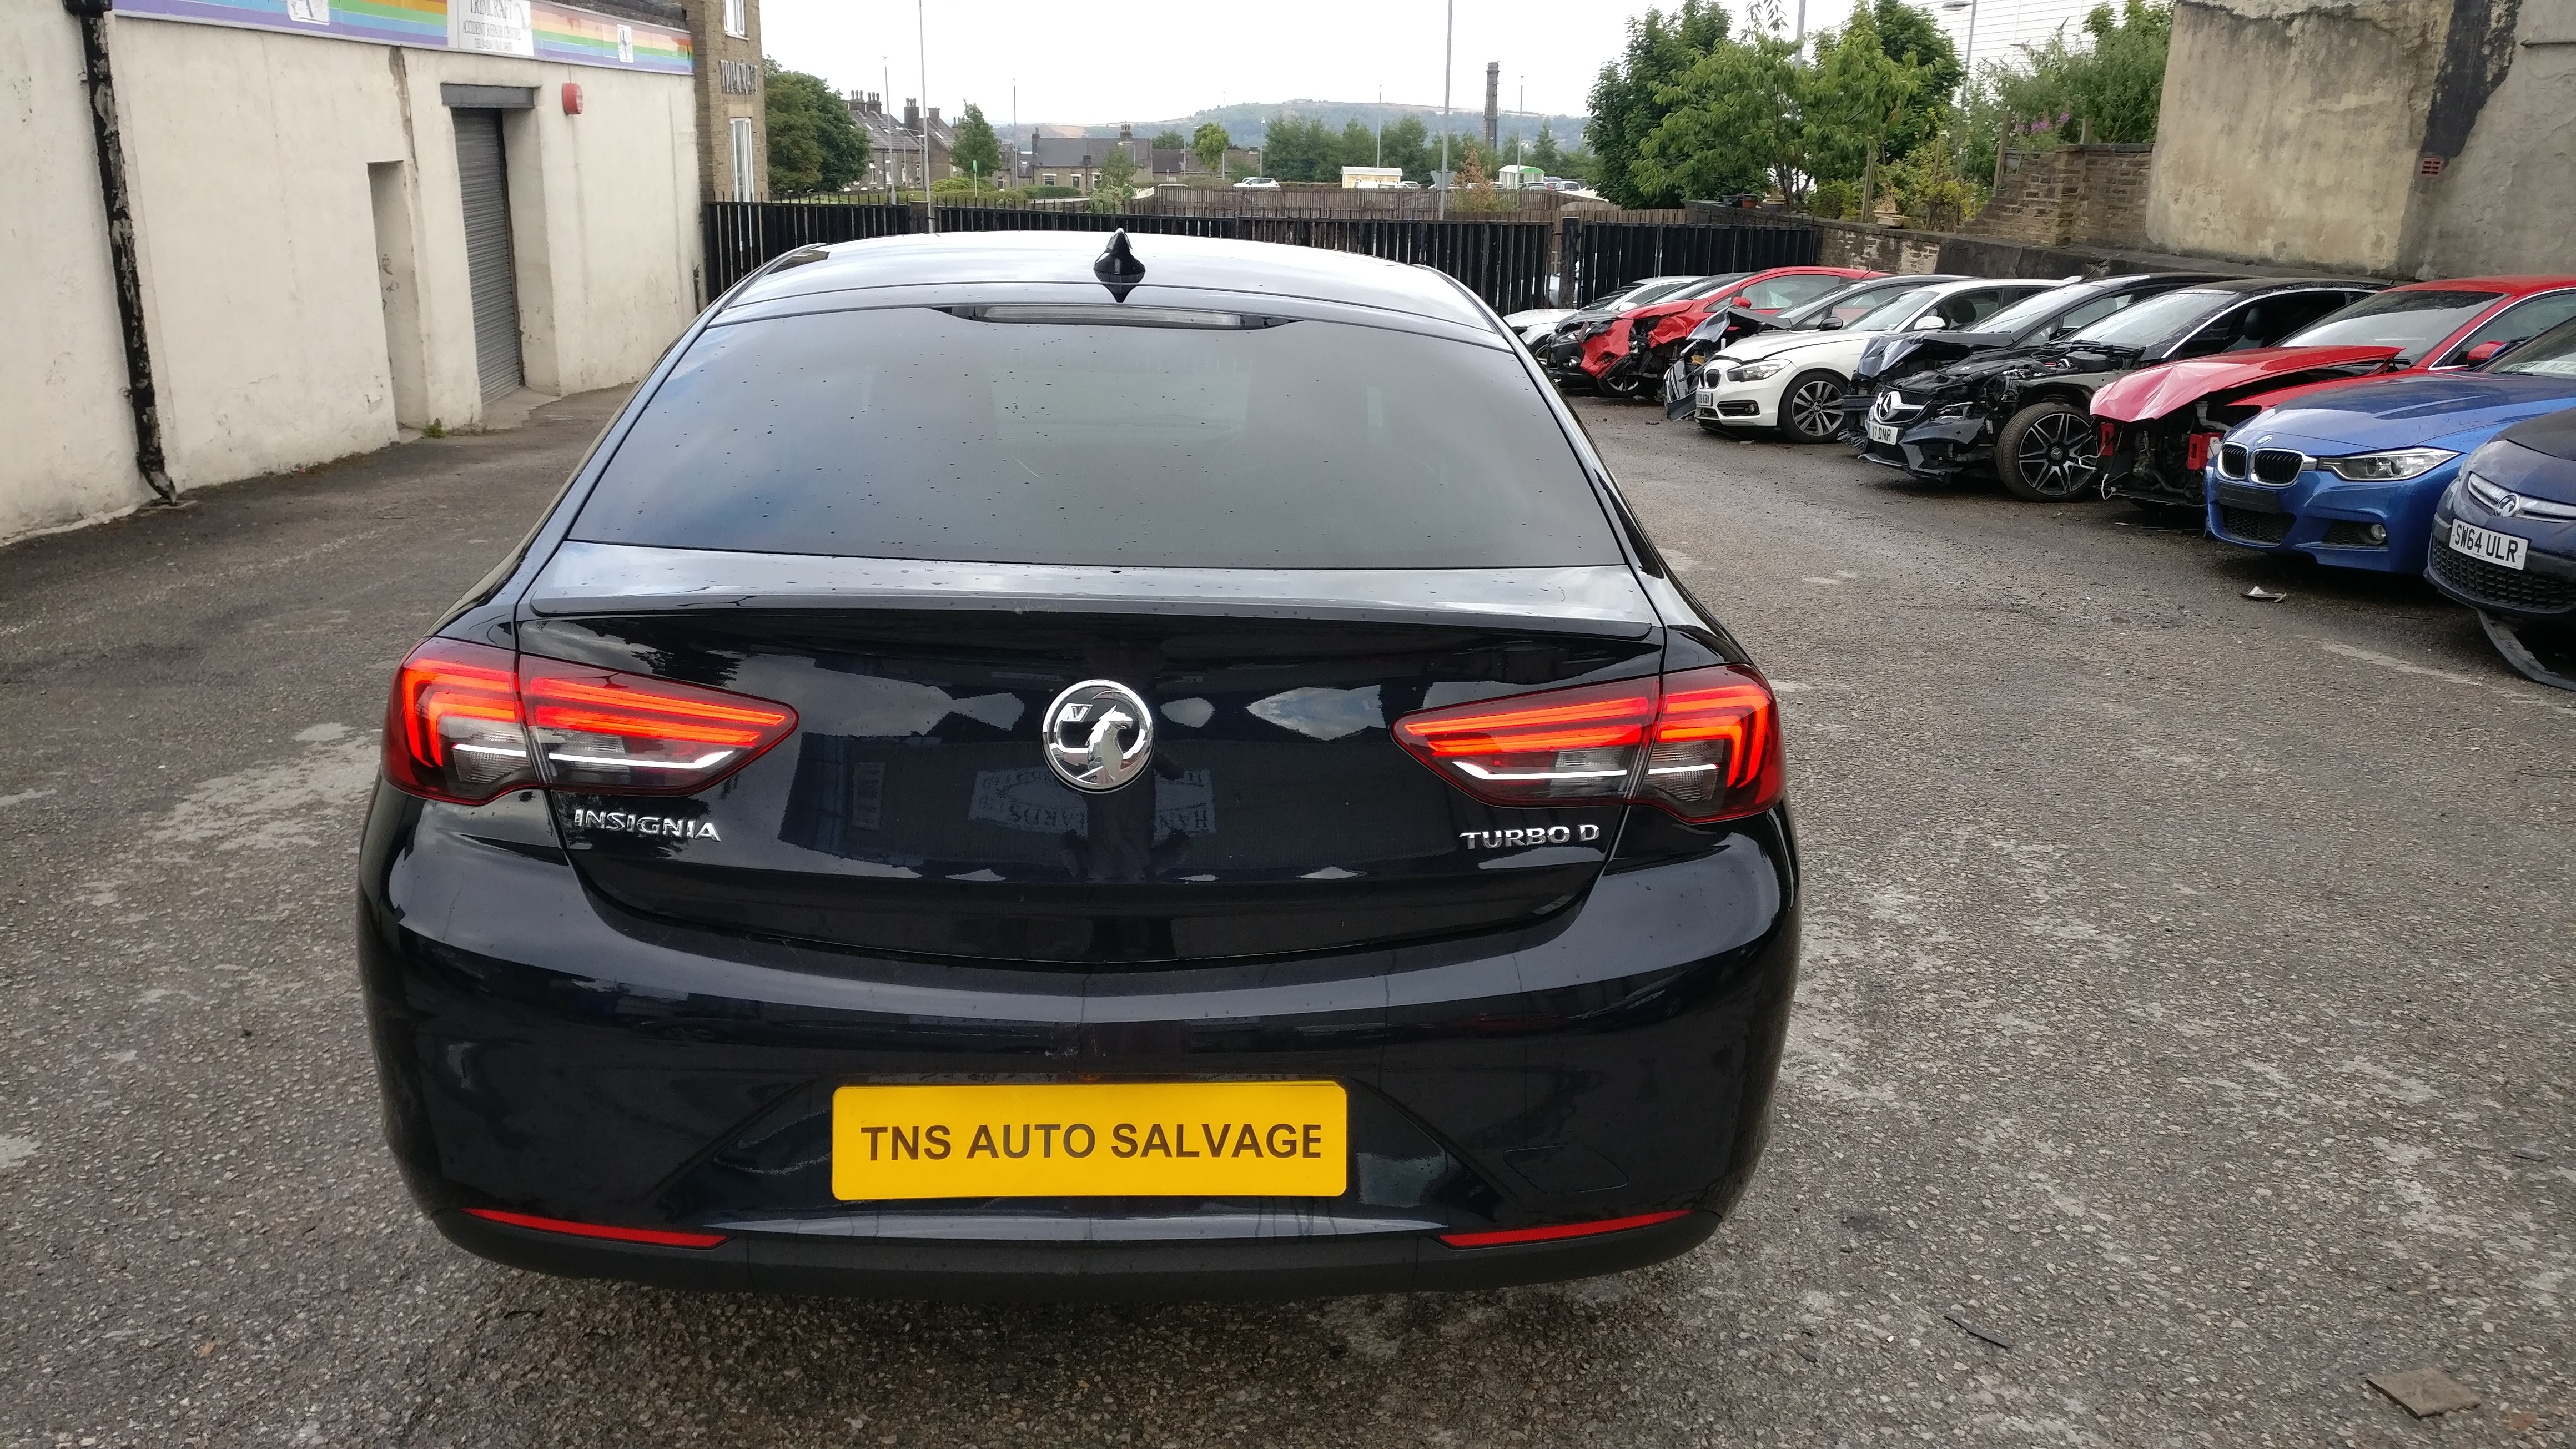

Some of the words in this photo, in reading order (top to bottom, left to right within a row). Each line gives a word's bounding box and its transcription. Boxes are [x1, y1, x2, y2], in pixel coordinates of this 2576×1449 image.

[2454, 524, 2483, 554] SW64
[2486, 534, 2519, 564] ULR
[574, 808, 722, 842] INSIGNIA
[1459, 826, 1571, 850] TURBO
[1578, 824, 1600, 842] D
[861, 1125, 952, 1161] TNS
[966, 1123, 1095, 1159] AUTO
[1111, 1123, 1322, 1159] SALVAGE
